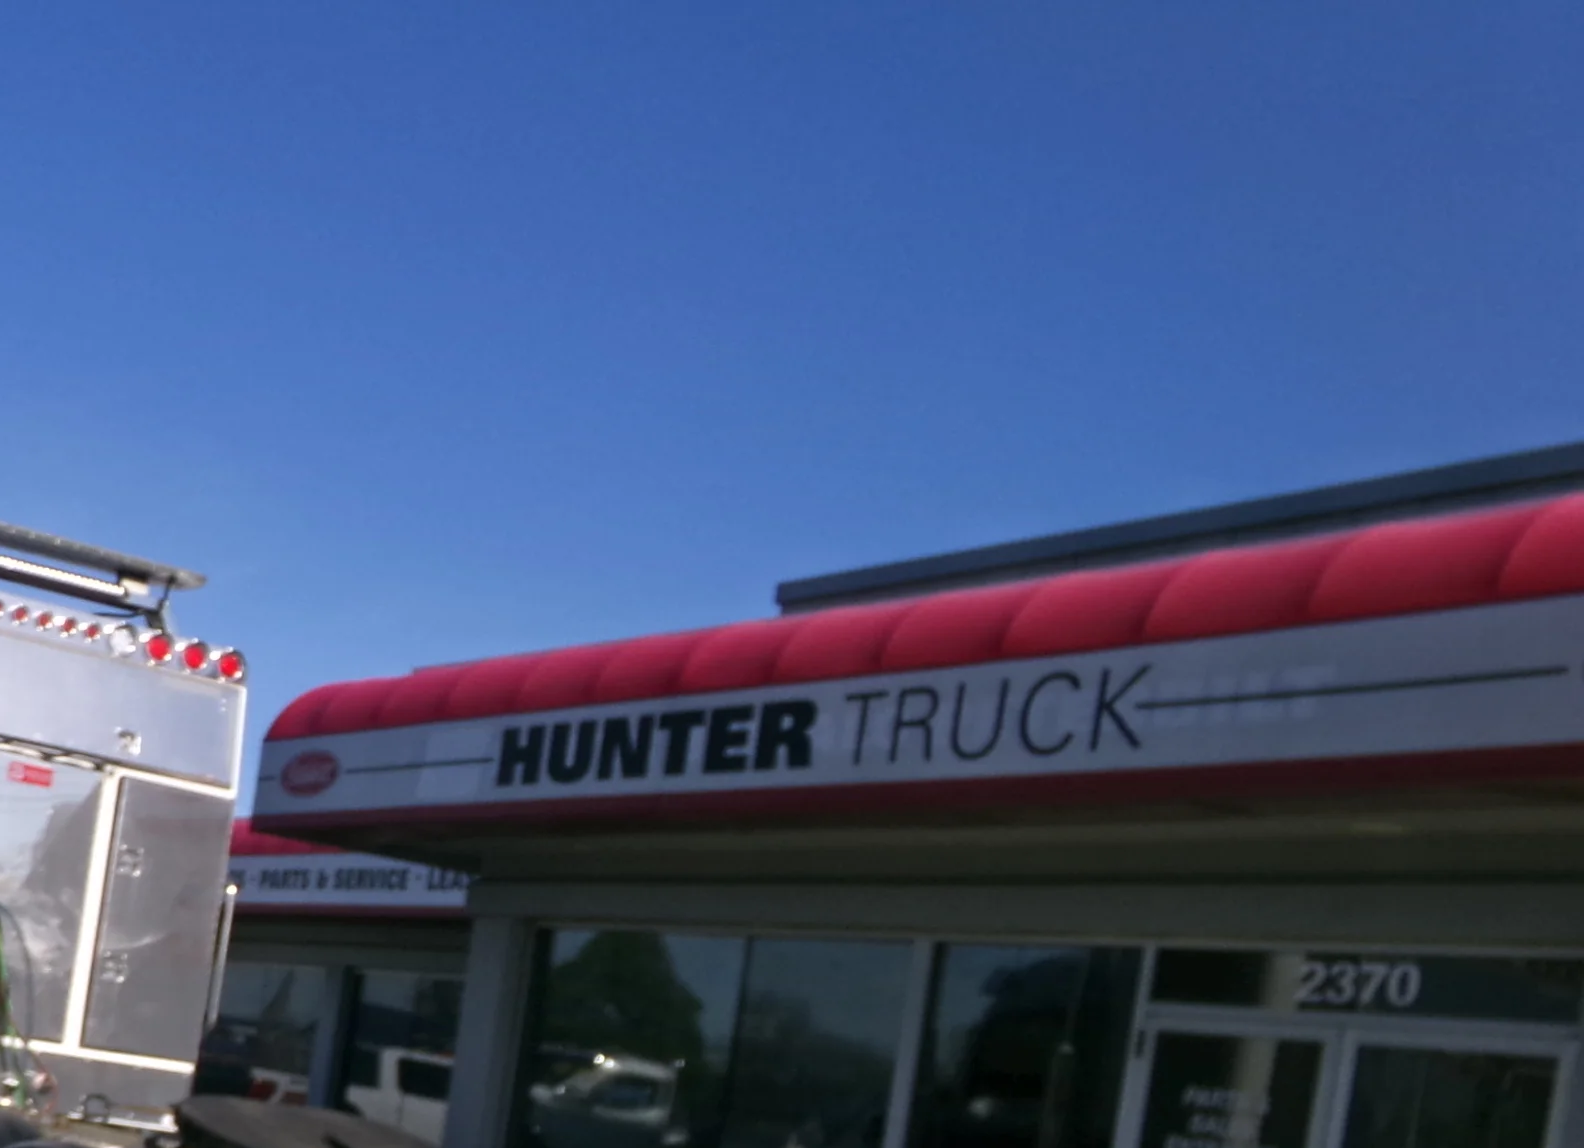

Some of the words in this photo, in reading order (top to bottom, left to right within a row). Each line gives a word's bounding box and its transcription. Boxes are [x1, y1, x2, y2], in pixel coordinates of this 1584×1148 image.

[495, 699, 819, 787] HUNTER
[846, 664, 1153, 766] TRUCK
[259, 868, 309, 891] PARTS
[318, 868, 328, 891] &
[332, 868, 410, 891] SERVICE
[1293, 960, 1422, 1007] 2370
